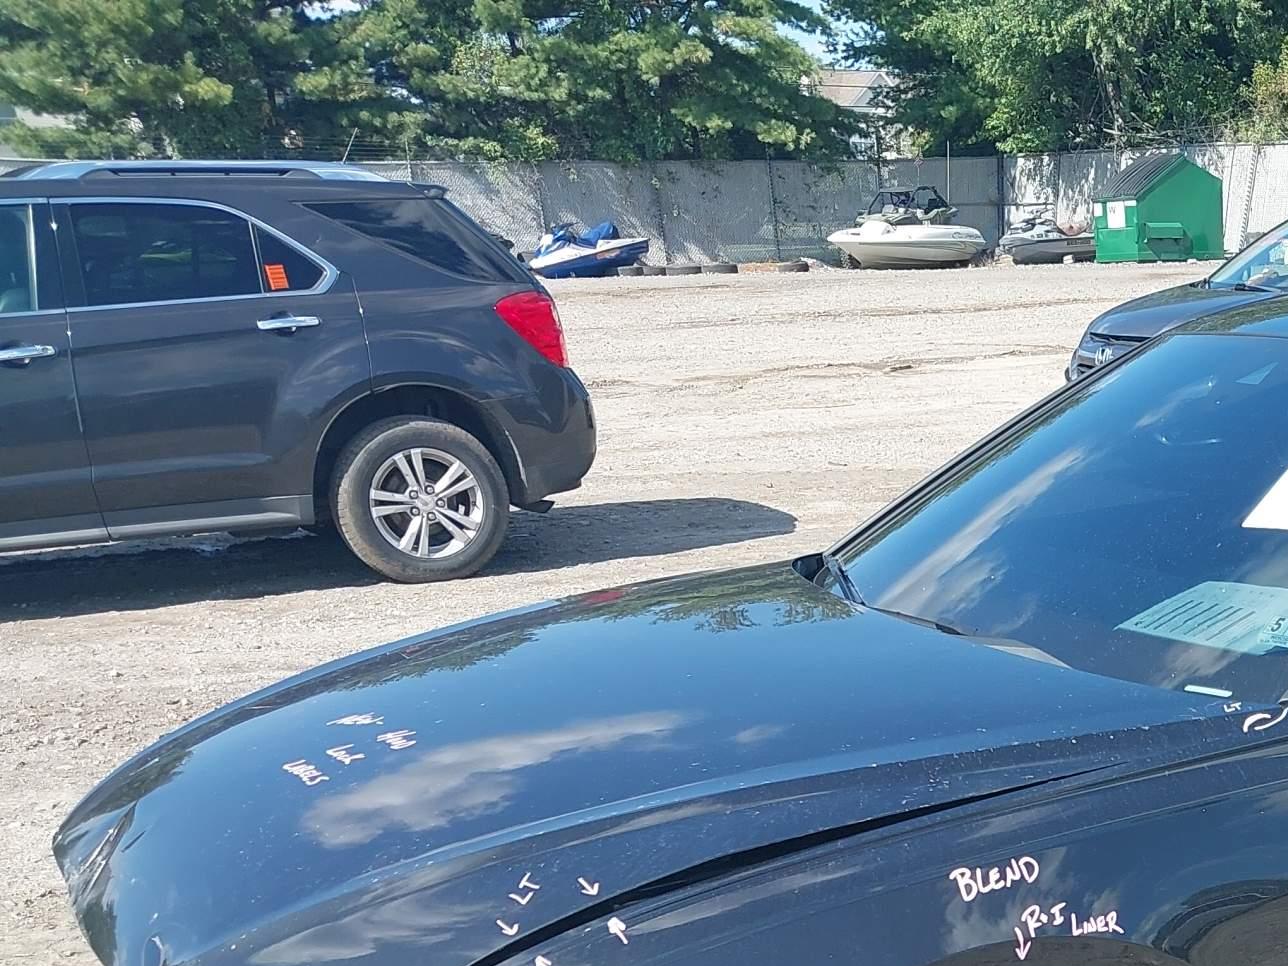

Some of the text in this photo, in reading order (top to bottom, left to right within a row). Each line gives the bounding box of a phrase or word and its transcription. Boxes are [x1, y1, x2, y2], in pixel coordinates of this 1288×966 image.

[1271, 618, 1285, 632] 5
[508, 872, 541, 906] LT
[949, 855, 1040, 902] BLEND
[1071, 910, 1125, 937] LINER
